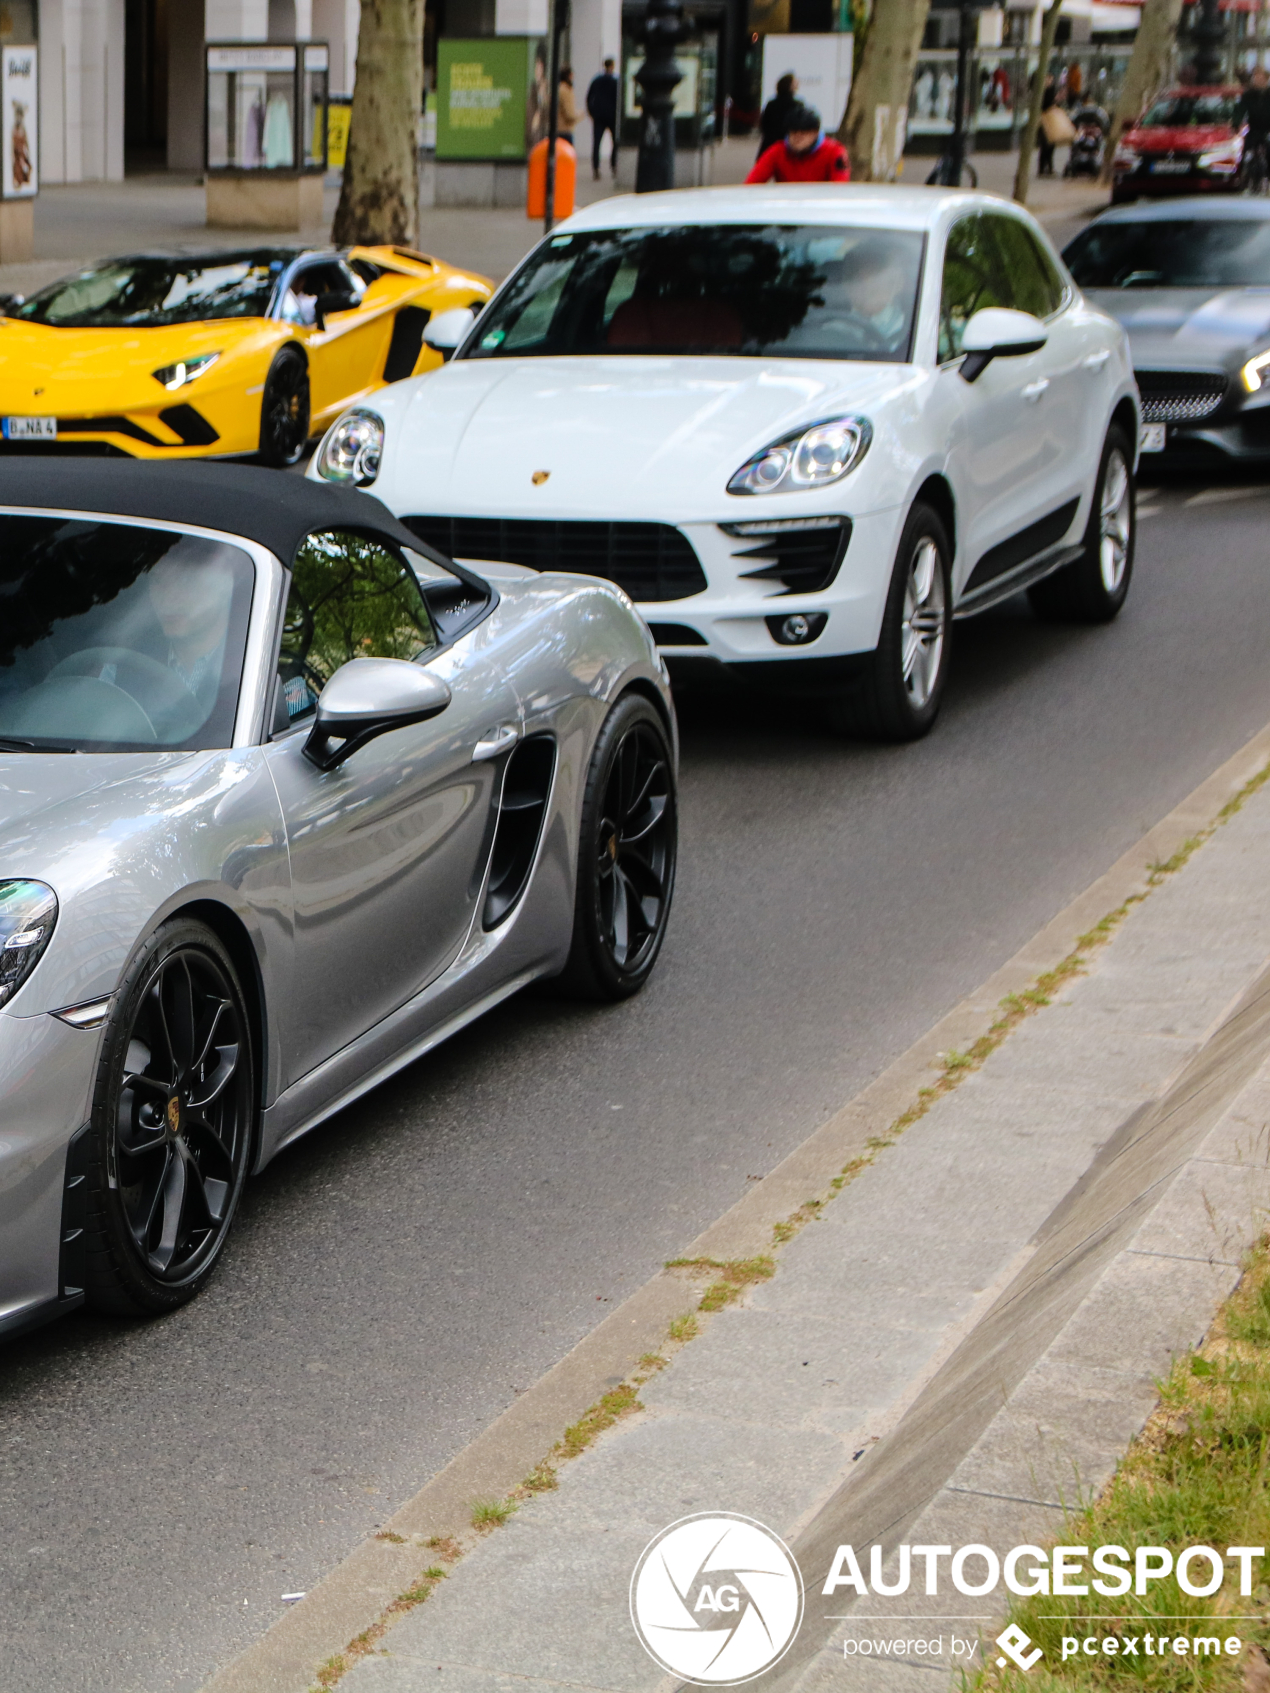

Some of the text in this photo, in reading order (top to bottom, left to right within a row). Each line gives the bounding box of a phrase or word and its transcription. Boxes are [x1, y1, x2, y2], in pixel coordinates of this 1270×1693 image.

[10, 418, 53, 434] B NA 4
